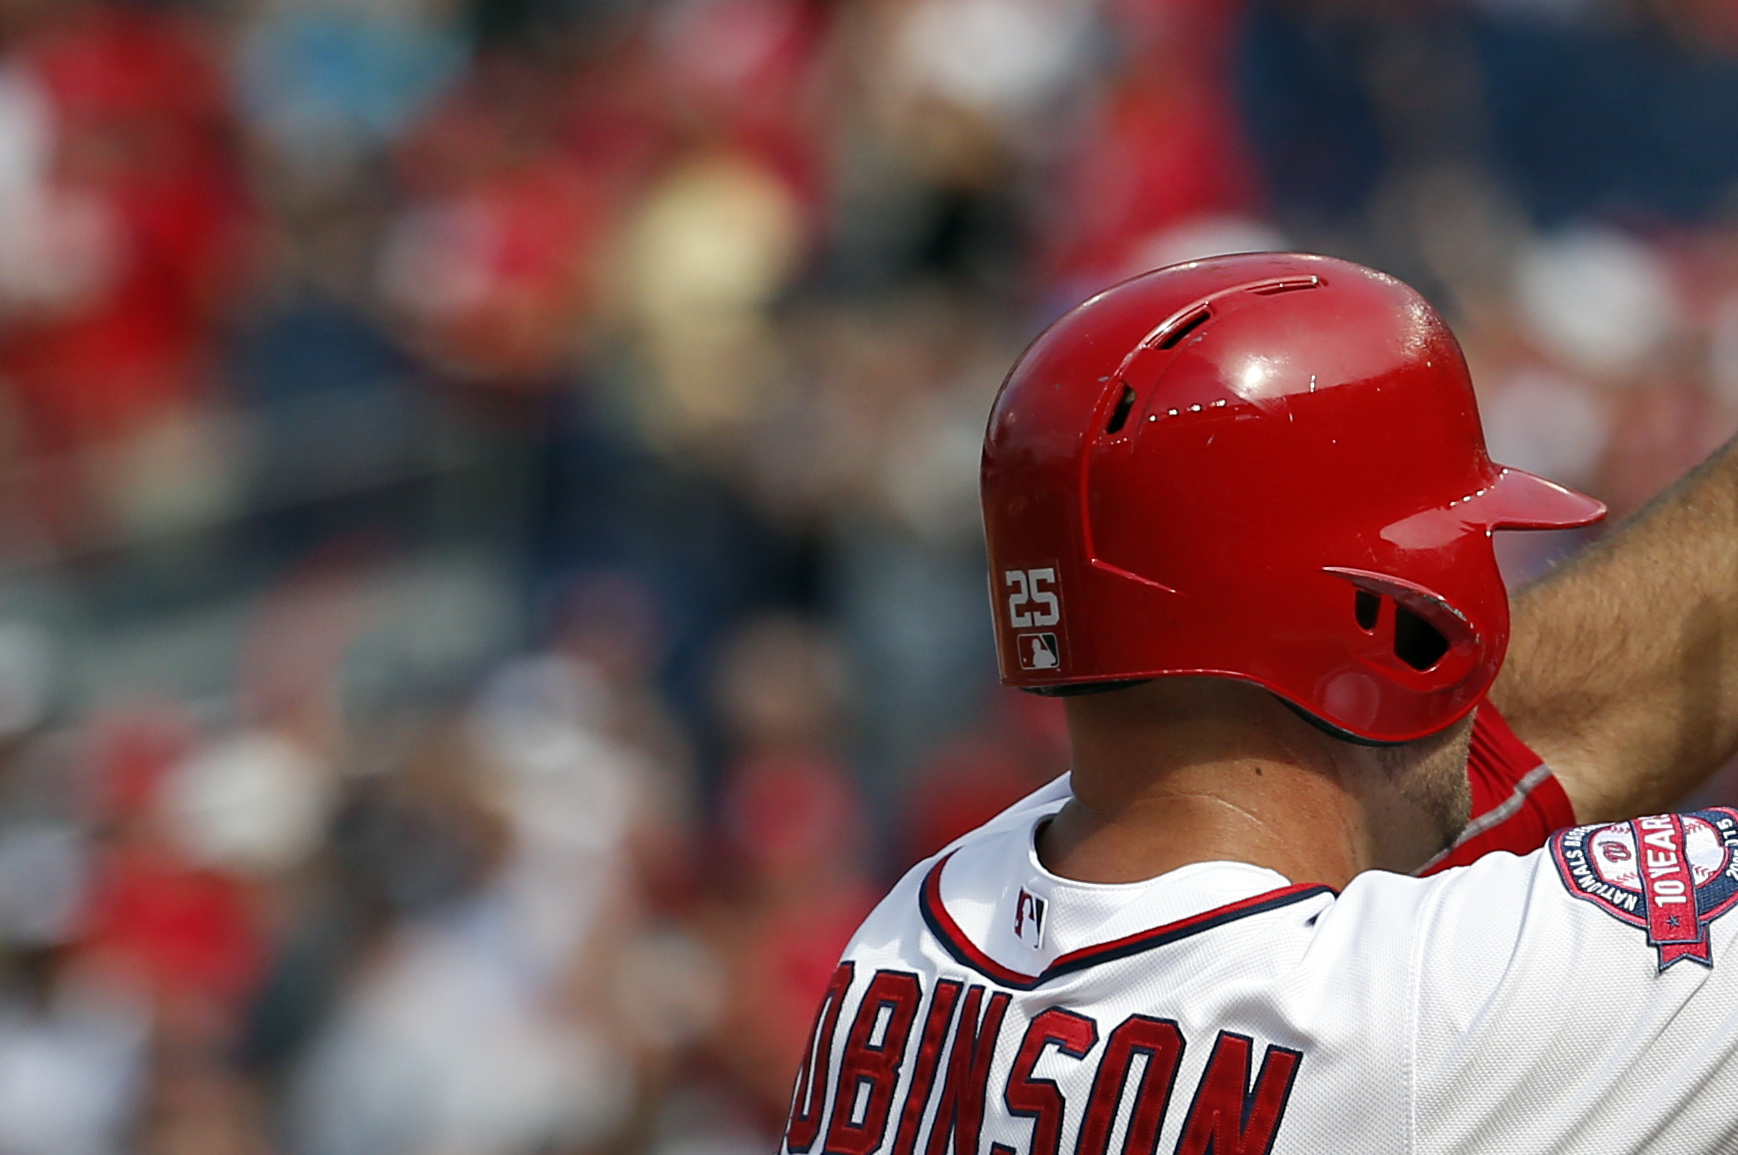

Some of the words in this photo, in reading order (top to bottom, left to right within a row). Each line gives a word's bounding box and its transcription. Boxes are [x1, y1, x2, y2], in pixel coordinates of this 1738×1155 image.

[1004, 567, 1061, 628] 25
[1640, 813, 1682, 879] YEAR
[1653, 879, 1688, 908] 10
